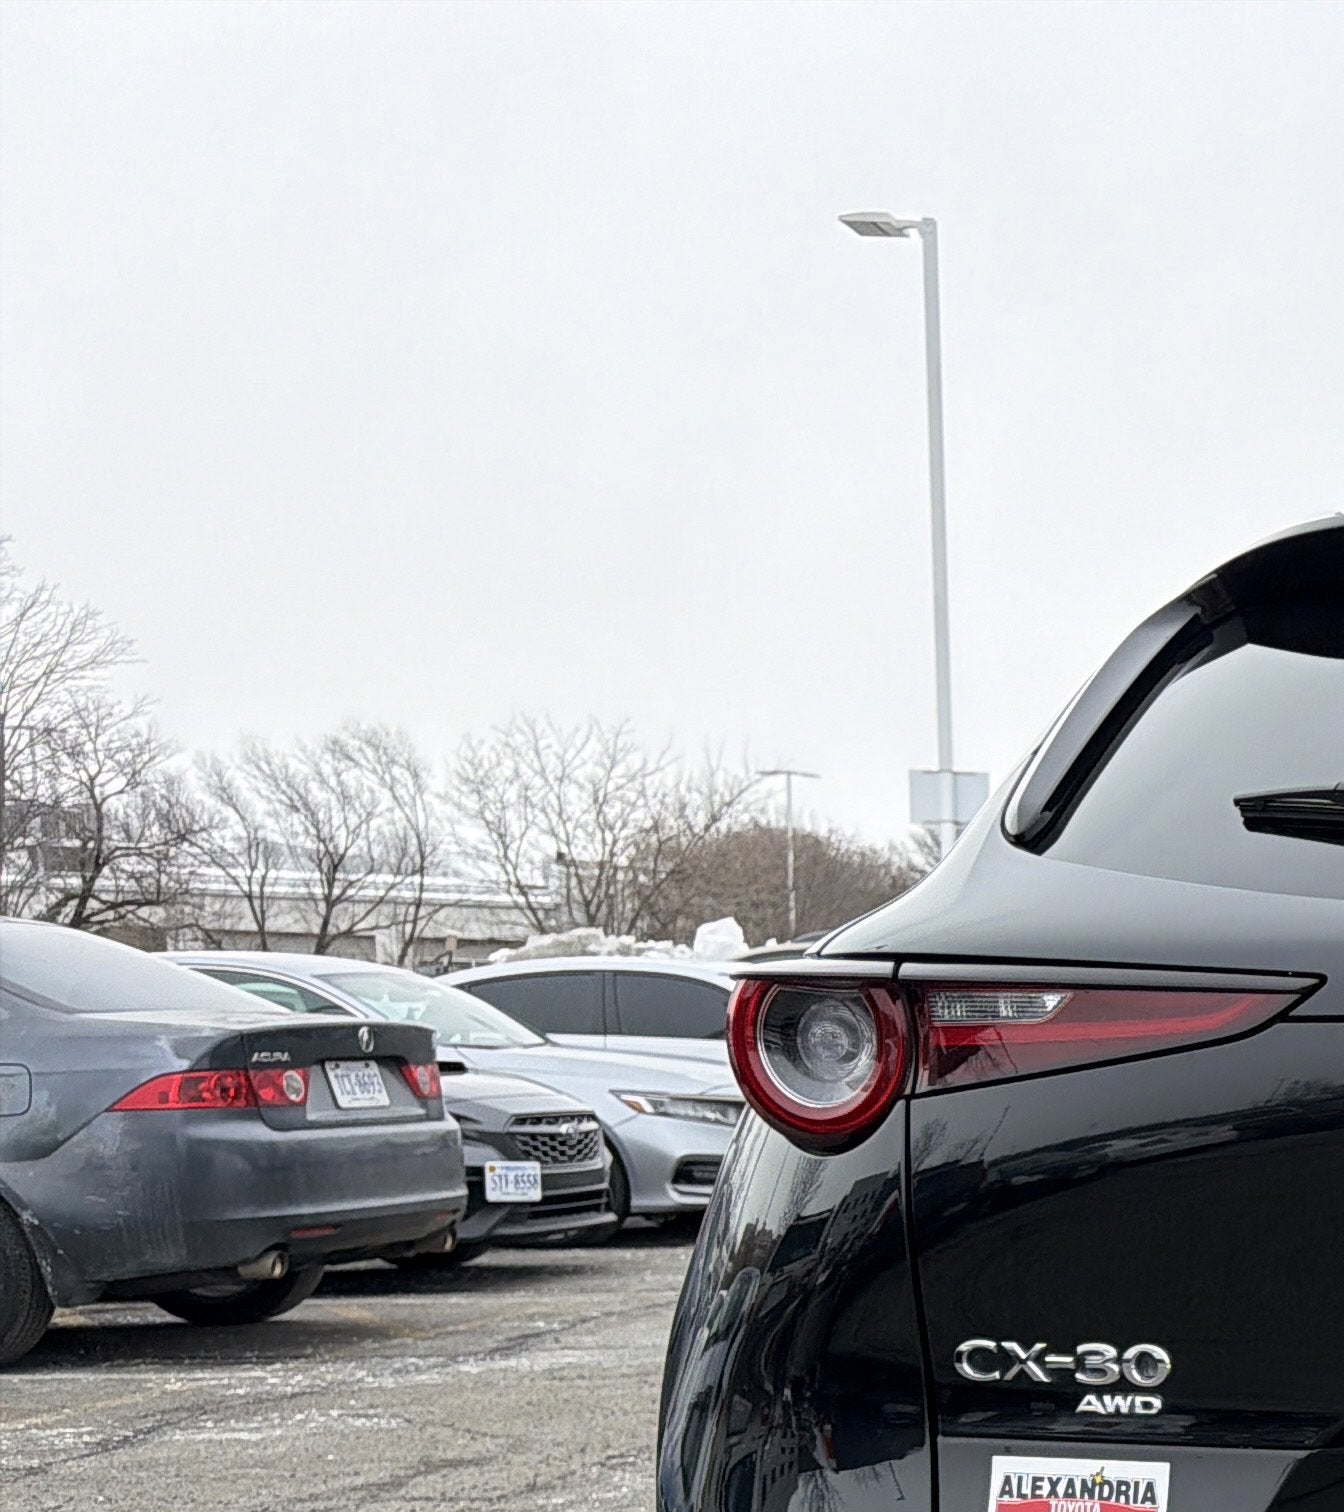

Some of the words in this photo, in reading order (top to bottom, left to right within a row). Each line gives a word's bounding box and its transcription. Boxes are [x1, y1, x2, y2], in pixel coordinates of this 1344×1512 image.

[954, 1339, 1172, 1387] CX-30
[1075, 1394, 1163, 1415] AWD
[999, 1473, 1159, 1506] ALEXANDRIA
